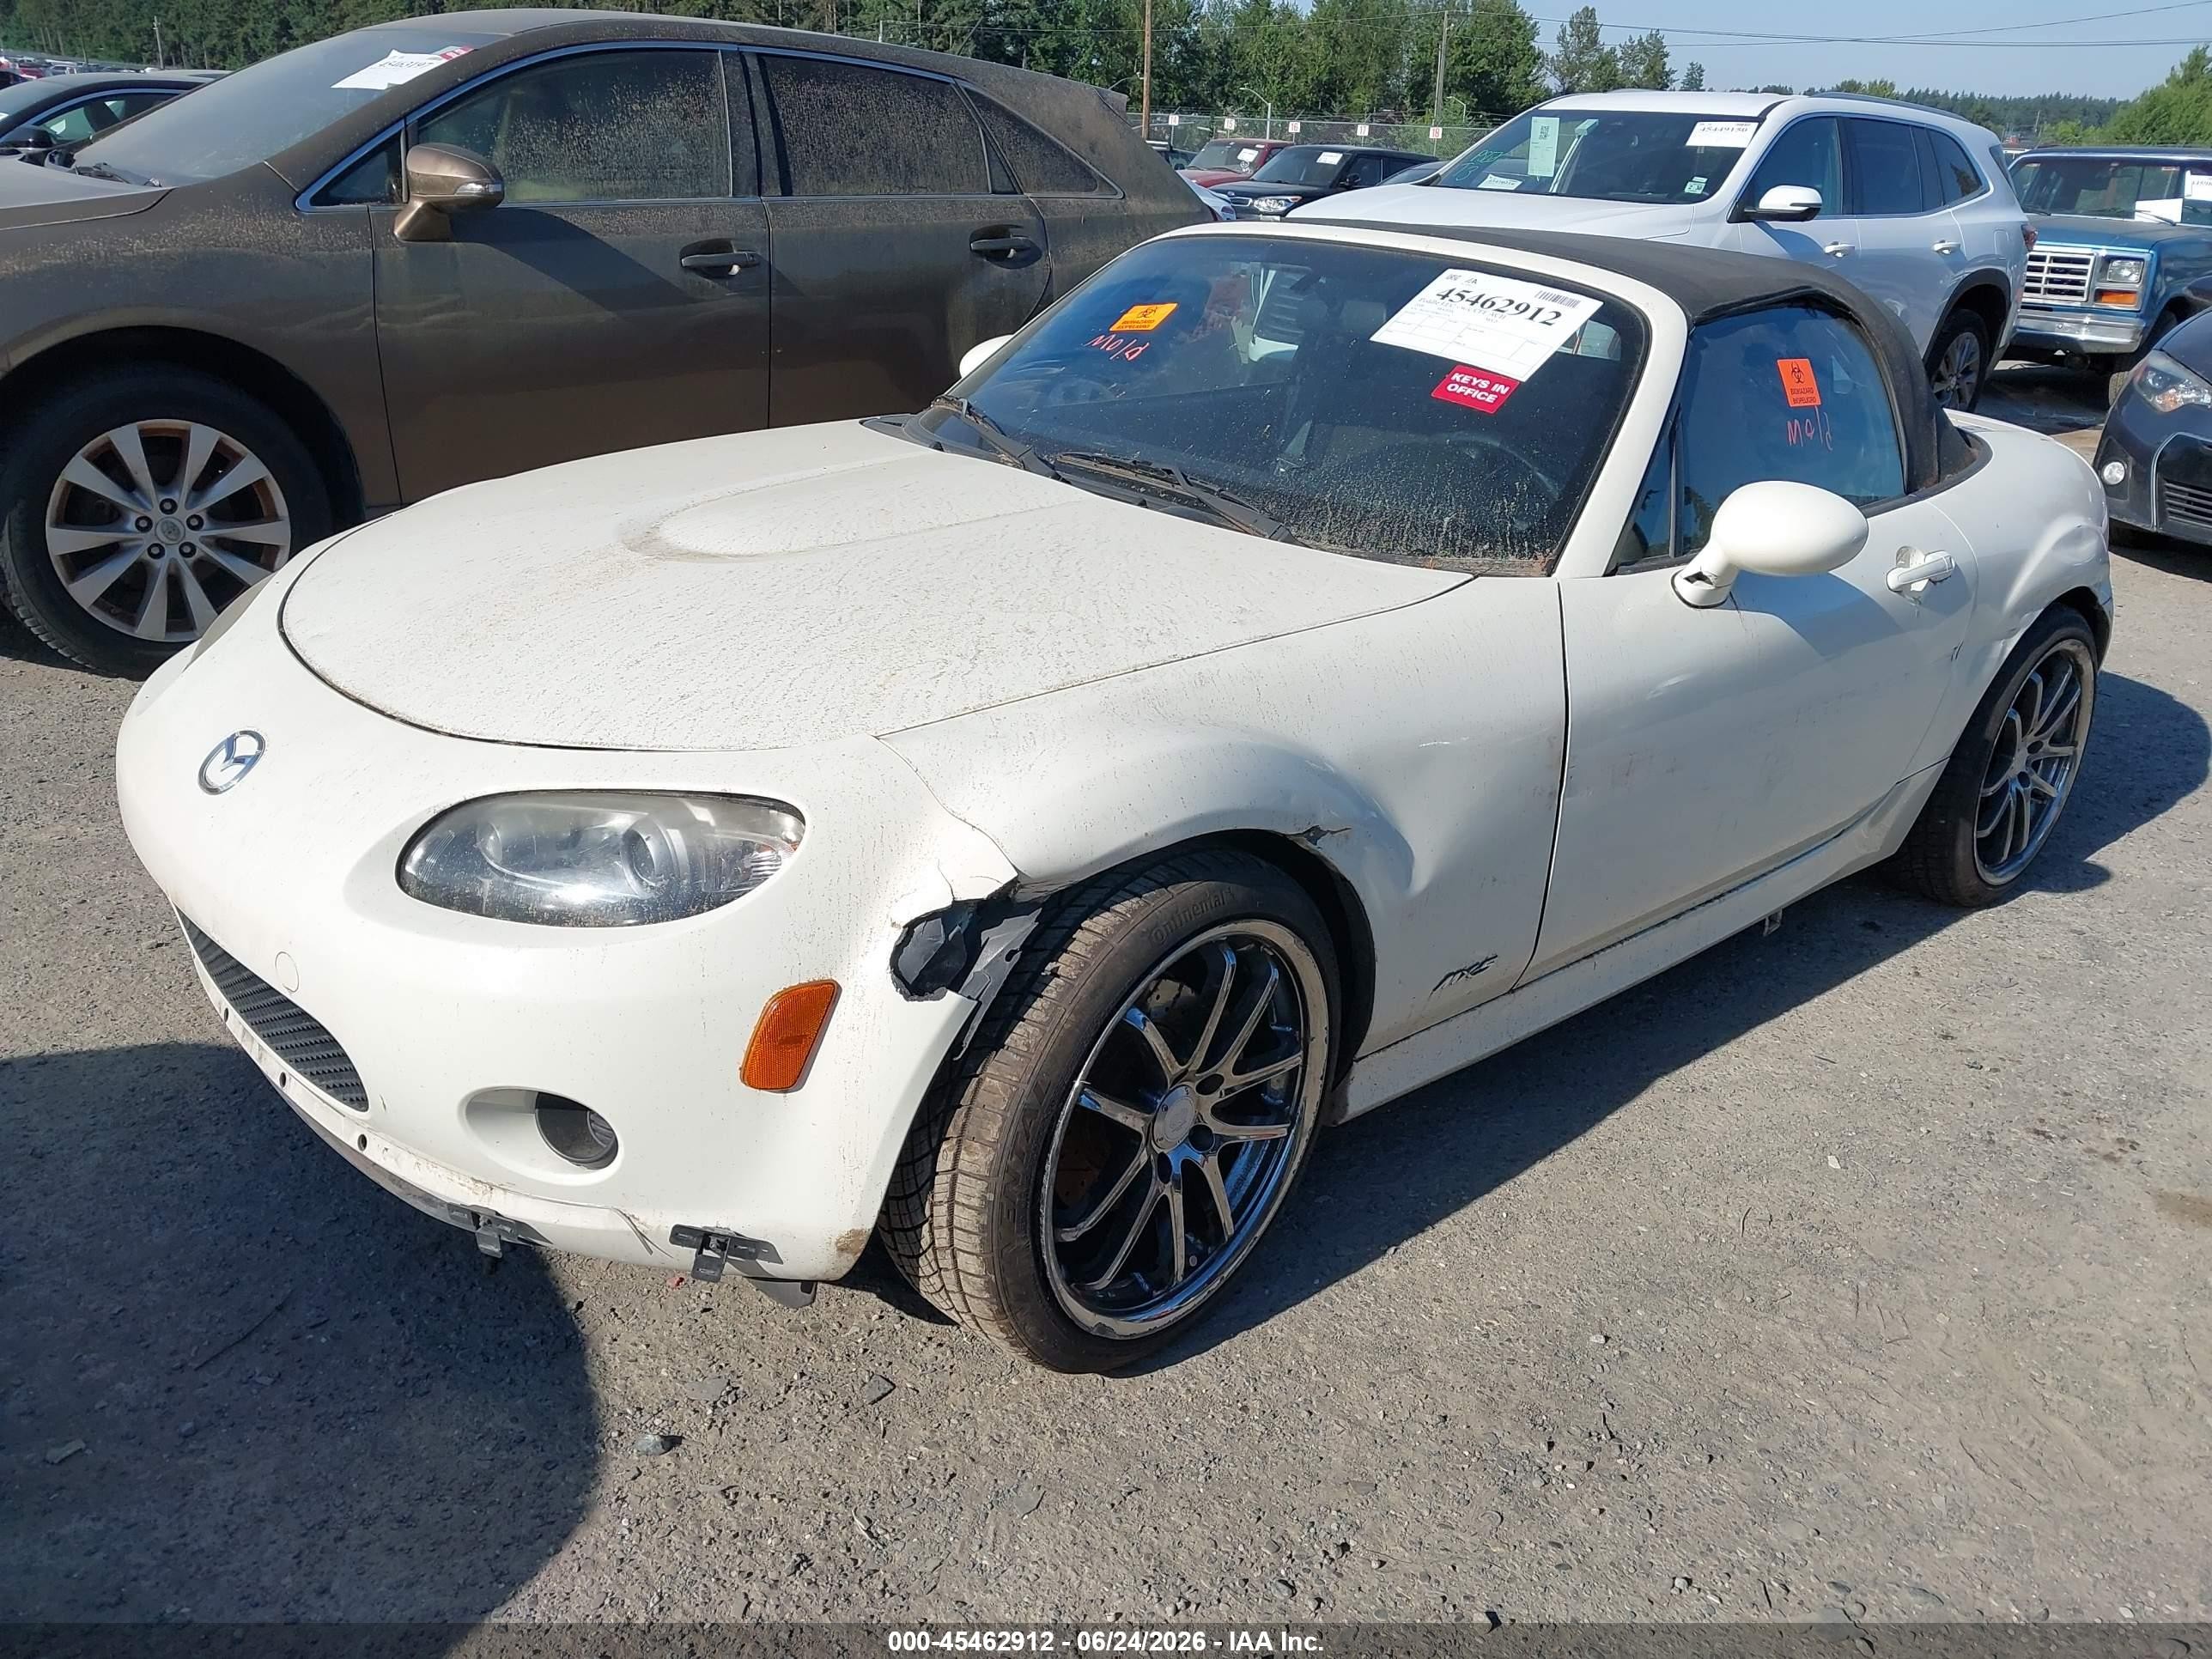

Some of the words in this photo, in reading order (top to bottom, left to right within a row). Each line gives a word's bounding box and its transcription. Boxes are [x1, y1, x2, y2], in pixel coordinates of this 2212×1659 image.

[1436, 288, 1562, 326] 45462912
[1447, 383, 1498, 404] OFFICE
[1451, 372, 1491, 389] KEYS
[1490, 381, 1510, 395] IN
